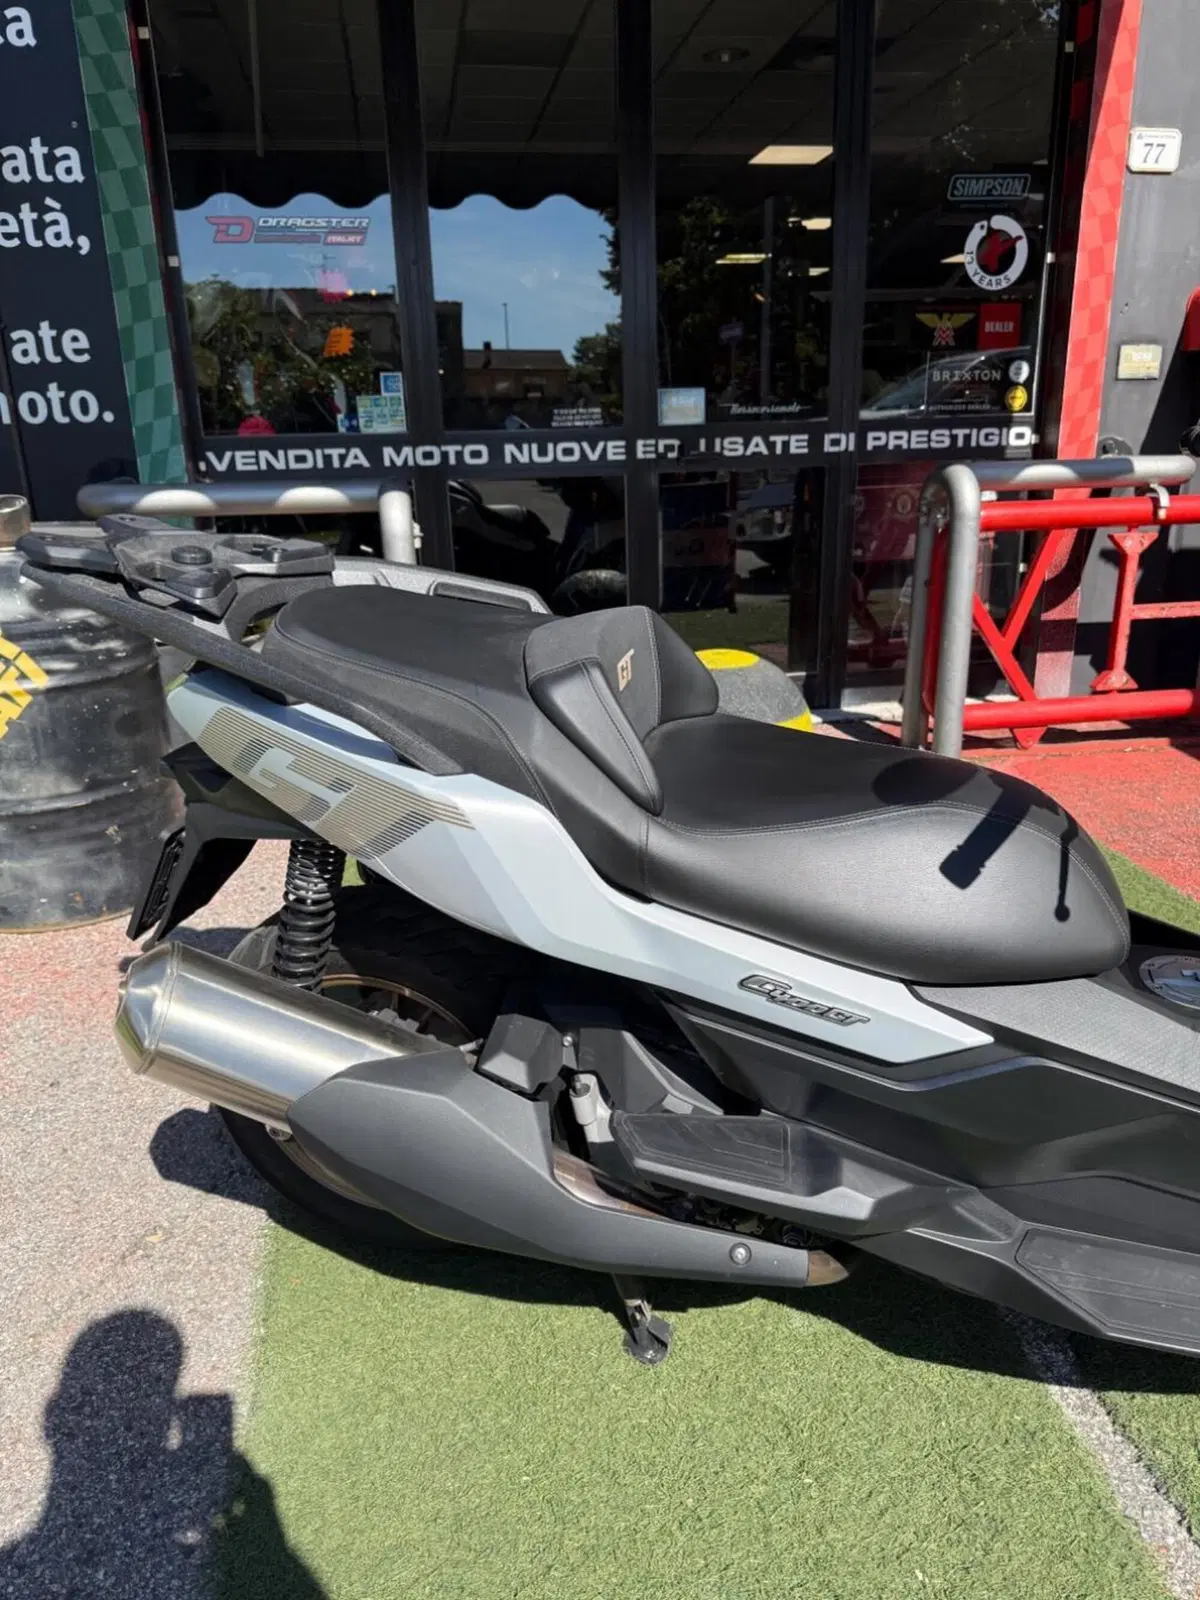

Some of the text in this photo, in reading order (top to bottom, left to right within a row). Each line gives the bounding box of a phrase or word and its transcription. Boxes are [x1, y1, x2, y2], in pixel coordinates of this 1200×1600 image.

[1142, 142, 1166, 165] 77
[953, 177, 1025, 197] SIMPSON
[258, 217, 370, 228] DRAGSTER
[972, 269, 1012, 288] YEARS
[984, 321, 1014, 333] DEALER
[10, 320, 91, 364] ate
[932, 369, 1001, 382] BRIXTON
[205, 446, 371, 472] VENDITA
[382, 443, 489, 468] MOTO
[504, 439, 626, 465] NUOVE
[824, 432, 855, 453] DI
[866, 426, 1032, 450] PRESTIGIO
